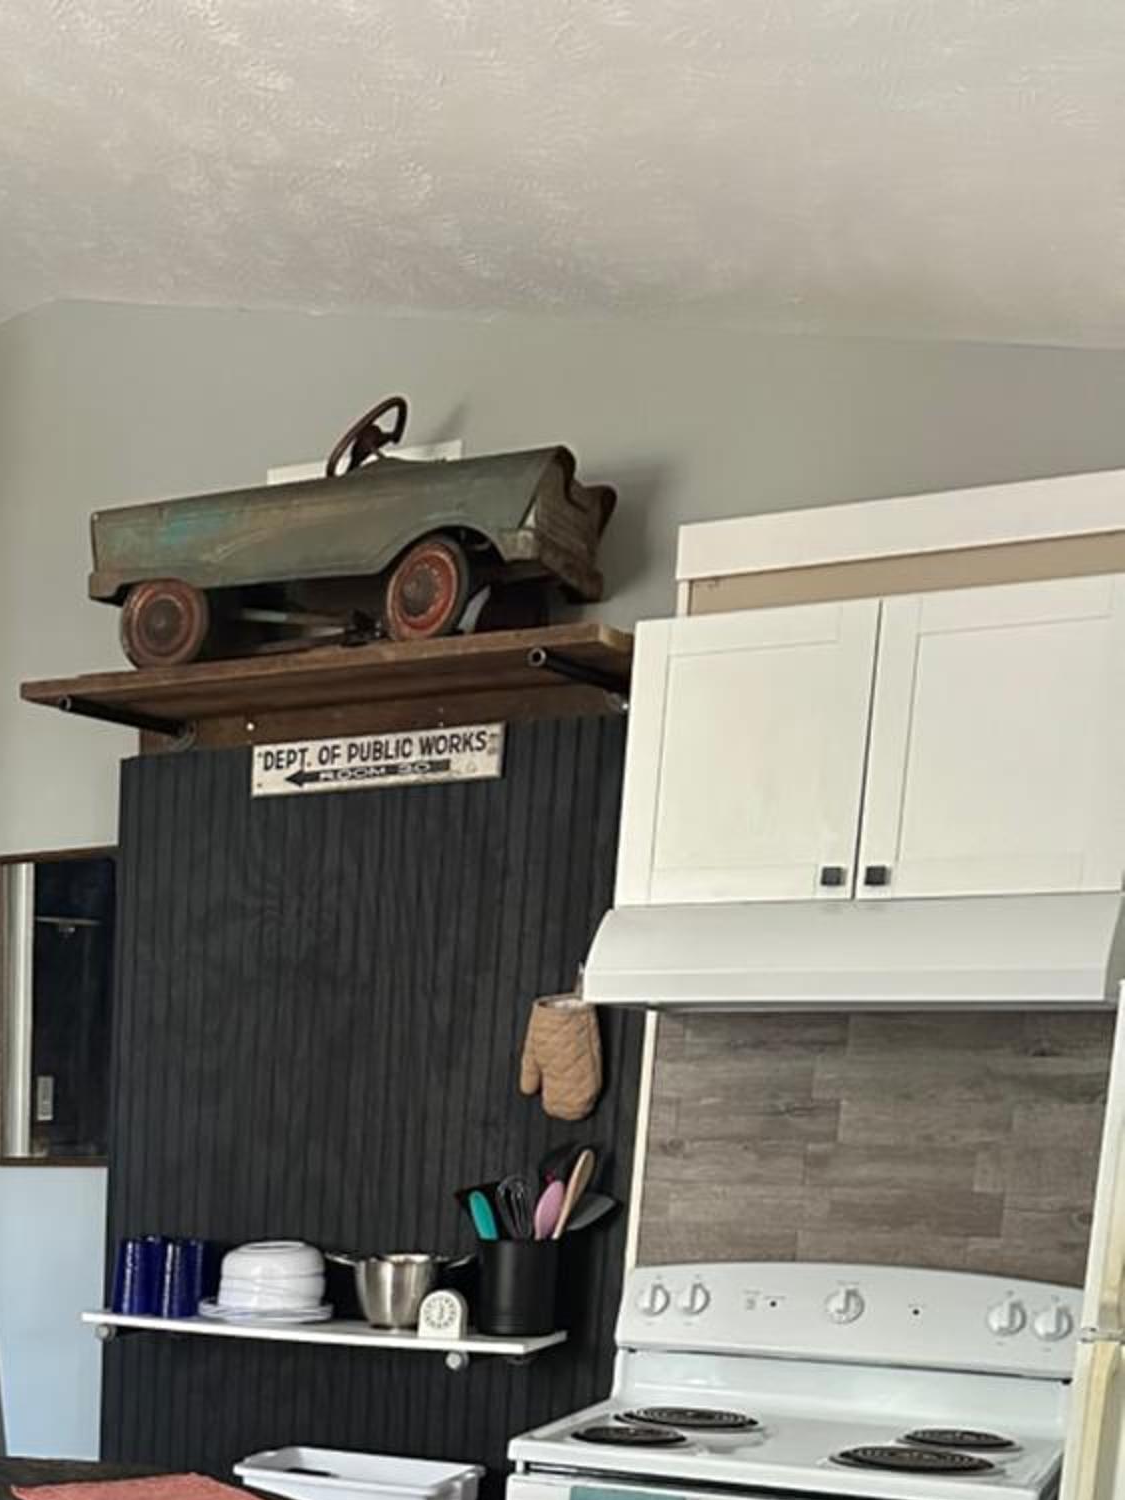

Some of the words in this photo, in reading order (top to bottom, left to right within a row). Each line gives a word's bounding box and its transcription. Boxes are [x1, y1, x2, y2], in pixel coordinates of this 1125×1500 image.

[318, 745, 342, 765] OF
[347, 736, 412, 763] PUBLIC
[418, 730, 487, 757] WORKS
